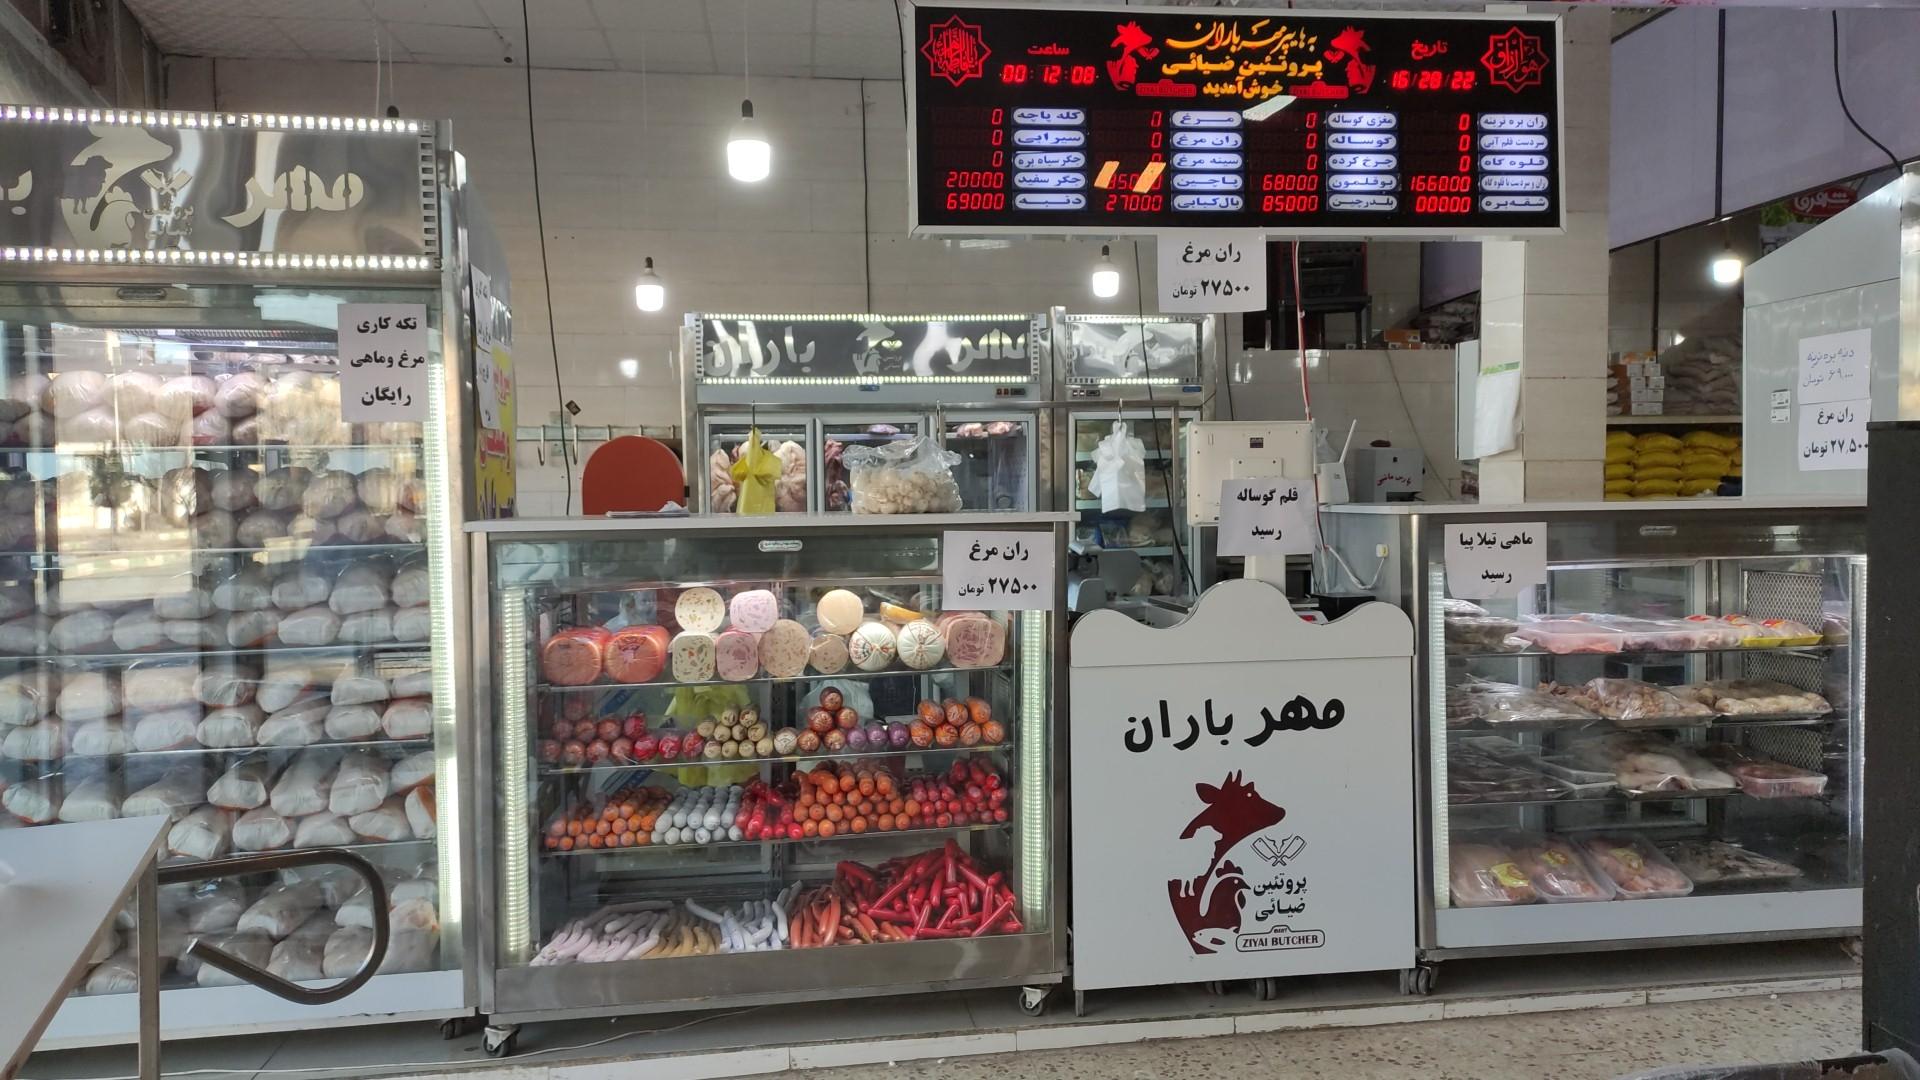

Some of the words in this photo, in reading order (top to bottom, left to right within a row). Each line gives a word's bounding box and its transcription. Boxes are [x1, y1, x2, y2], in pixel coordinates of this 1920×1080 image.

[1166, 21, 1241, 53] باران
[1027, 43, 1071, 56] ساعت
[1411, 40, 1448, 60] تاریخ
[1238, 56, 1323, 80] پروتئین
[1202, 75, 1246, 97] آمدید
[1242, 79, 1283, 99] خوش
[992, 108, 1003, 125] 0
[1151, 111, 1162, 127] 0
[1180, 112, 1234, 125] مرغ
[1306, 112, 1317, 128] 0
[1459, 114, 1470, 131] 0
[1527, 117, 1544, 128] ران
[992, 129, 1003, 146] 0
[1151, 132, 1162, 148] 0
[1176, 134, 1207, 146] مرغ
[1211, 135, 1239, 146] ران
[1306, 133, 1317, 149] 0
[1459, 134, 1470, 151] 0
[992, 150, 1003, 167] 0
[1176, 154, 1205, 167] مرغ
[1307, 154, 1318, 170] 0
[1332, 156, 1359, 167] کرده
[1459, 155, 1470, 172] 0
[946, 171, 1004, 188] 20000
[1018, 174, 1050, 185] سفید
[1263, 174, 1318, 191] 68000
[1410, 175, 1471, 192] 166000
[946, 193, 1004, 210] 69000
[1019, 195, 1082, 207] دنبه
[1106, 194, 1162, 211] 27000
[1263, 195, 1318, 211] 85000
[1416, 196, 1471, 212] 00000
[1182, 241, 1211, 263] مرغ
[1215, 241, 1241, 263] ران
[1172, 285, 1198, 298] تومان
[1200, 279, 1250, 297] ۲۷۵۰۰
[356, 316, 392, 334] کاری
[395, 316, 418, 330] تکه
[397, 349, 425, 369] مرغ
[361, 386, 412, 406] رایگان
[1817, 407, 1834, 425] مرغ
[1837, 407, 1854, 422] ران
[1803, 440, 1828, 458] تومان
[1279, 487, 1299, 505] قلم
[1251, 525, 1282, 540] رسید
[1500, 531, 1533, 549] ماهی
[969, 539, 998, 561] مرغ
[1002, 541, 1029, 561] ران
[1481, 569, 1512, 583] رسید
[958, 583, 985, 596] تومان
[988, 577, 1037, 594] ۲۷۵۰۰
[1124, 699, 1233, 753] باران
[1244, 695, 1345, 747] مهر
[1253, 872, 1308, 896] پروتئین
[1255, 897, 1306, 921] ضیائی
[1242, 937, 1268, 948] ZIYAI
[1271, 934, 1319, 947] BUTCHER
